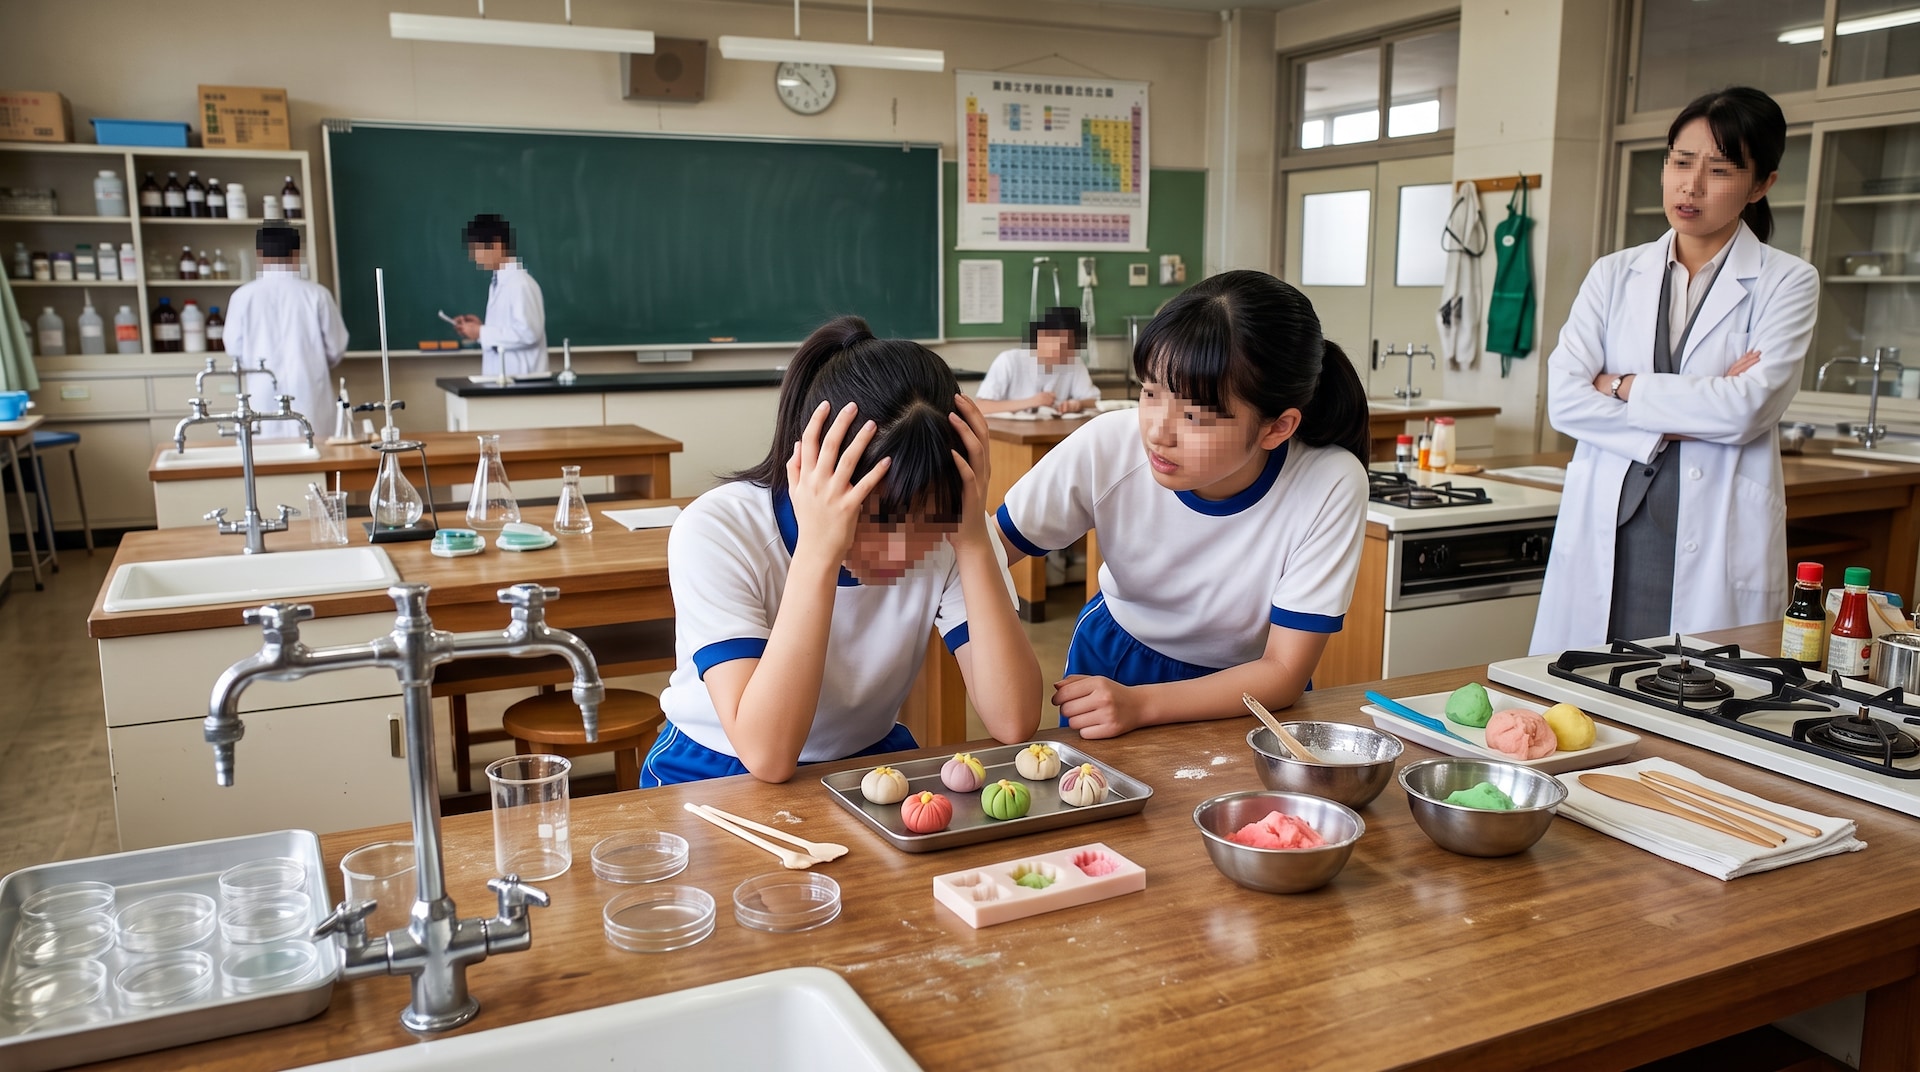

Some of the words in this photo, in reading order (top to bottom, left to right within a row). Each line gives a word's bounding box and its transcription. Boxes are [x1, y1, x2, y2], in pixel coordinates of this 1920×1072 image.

[820, 69, 827, 78] 2
[824, 79, 830, 88] 3
[804, 100, 810, 109] 6
